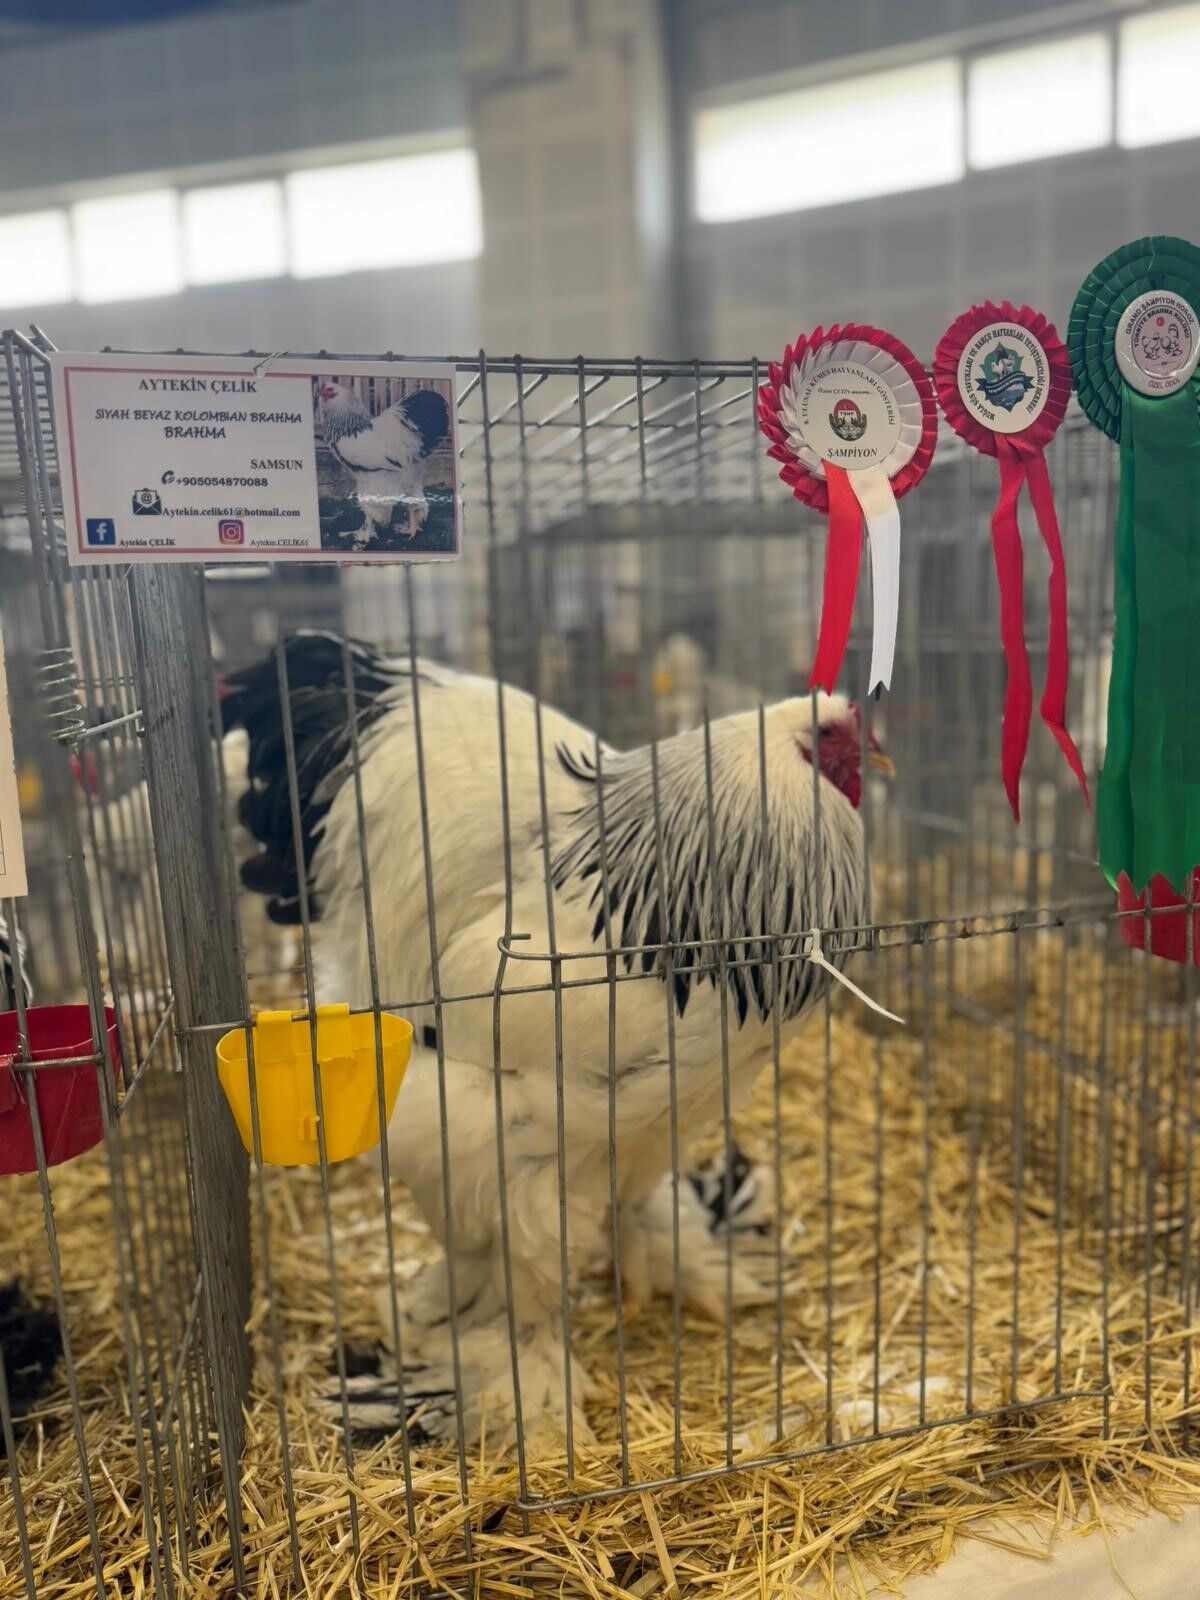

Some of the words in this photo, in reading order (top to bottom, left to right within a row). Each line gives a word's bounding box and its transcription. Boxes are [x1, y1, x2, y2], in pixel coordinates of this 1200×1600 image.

[138, 377, 206, 391] AYTEKİN
[210, 378, 257, 394] ÇELİK
[133, 409, 172, 421] BEYAZ
[250, 411, 302, 423] BRAHMA
[163, 426, 226, 439] BRAHMA
[827, 446, 878, 459] ŞAMPİYON
[250, 459, 303, 470] SAMSUN
[176, 476, 269, 487] +905054870088
[162, 507, 300, 517] Aytekin.celik61@hotmail.com
[119, 538, 148, 547] Aytekin
[149, 538, 176, 547] ÇELİK
